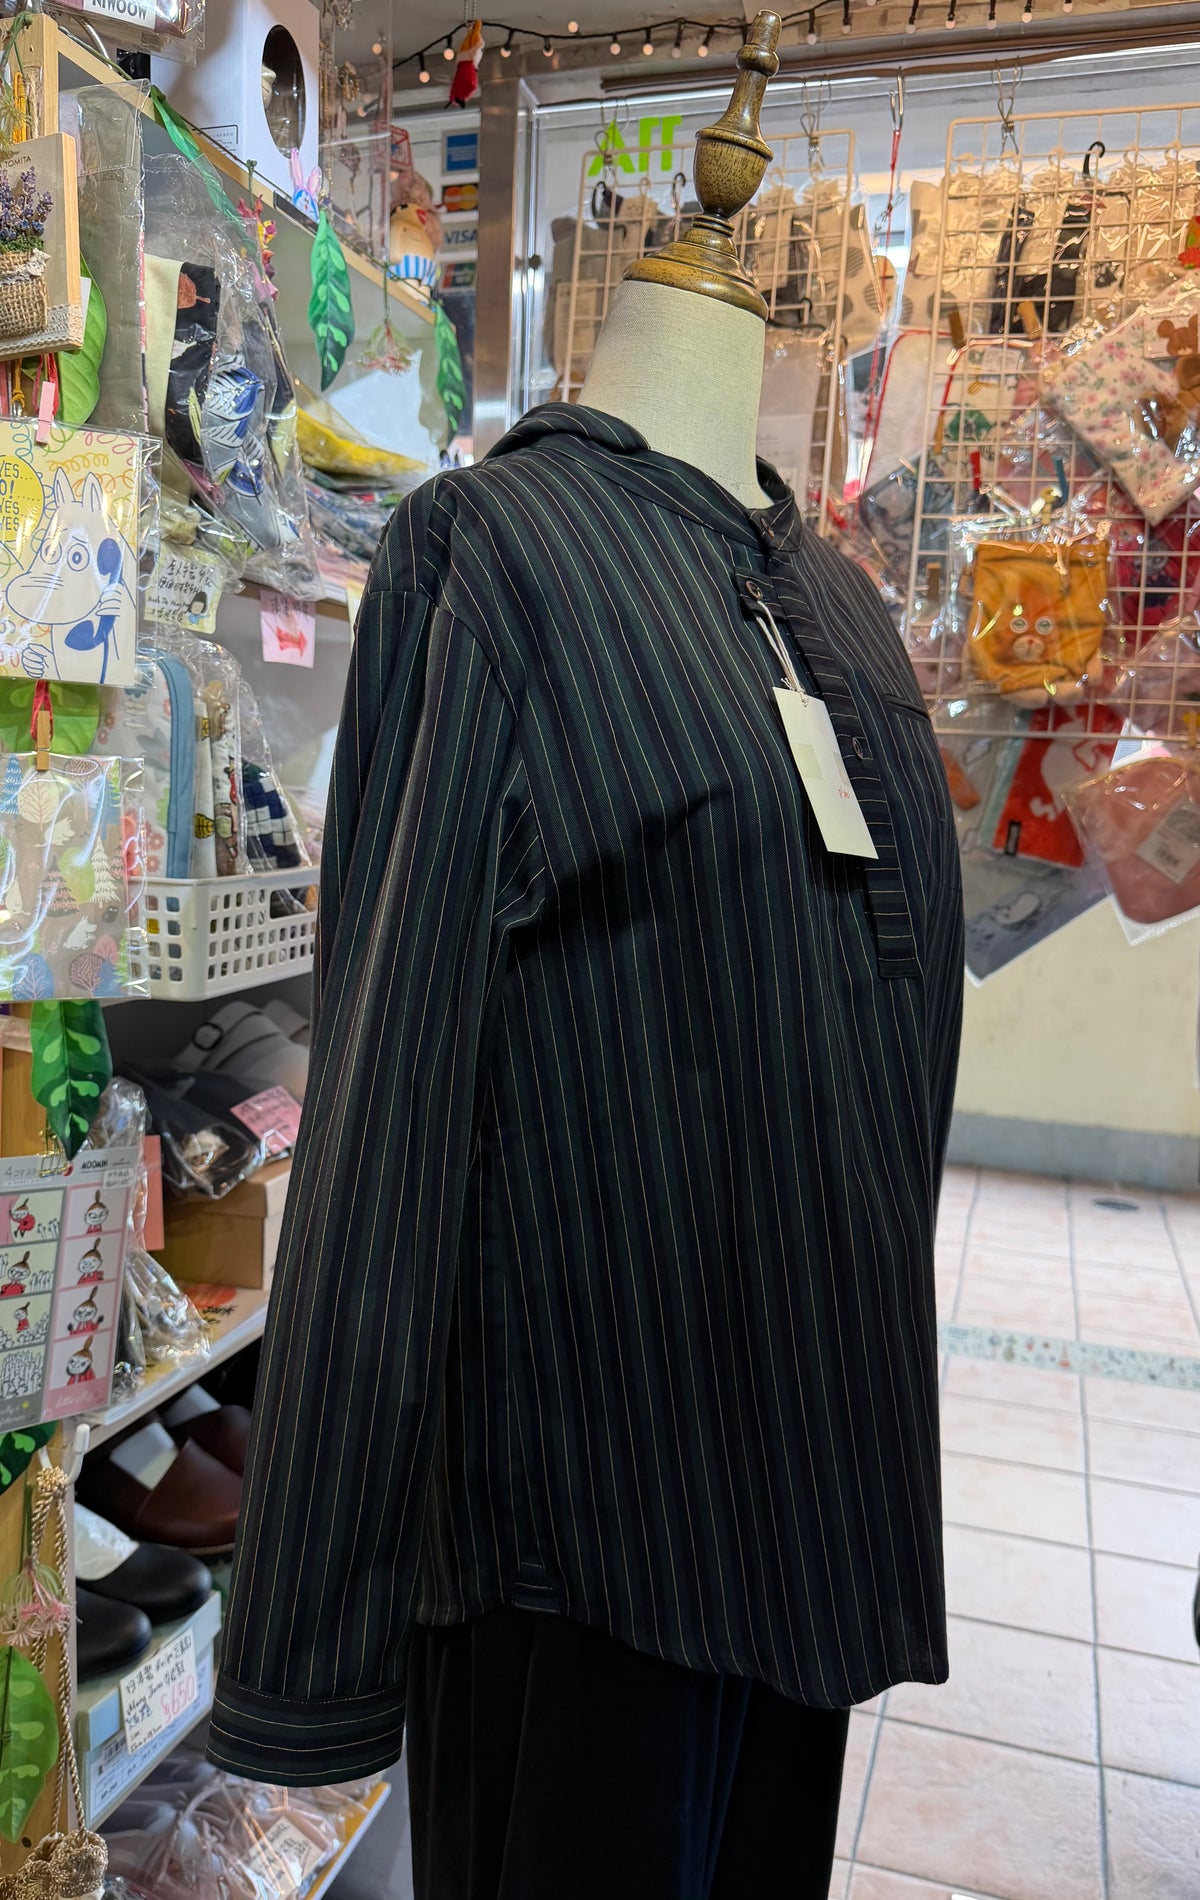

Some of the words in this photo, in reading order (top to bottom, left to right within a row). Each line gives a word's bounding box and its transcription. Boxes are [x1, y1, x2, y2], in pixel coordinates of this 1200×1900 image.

[4, 155, 32, 168] TOMITA
[444, 229, 478, 245] VISA
[81, 1159, 109, 1170] MOOMIN
